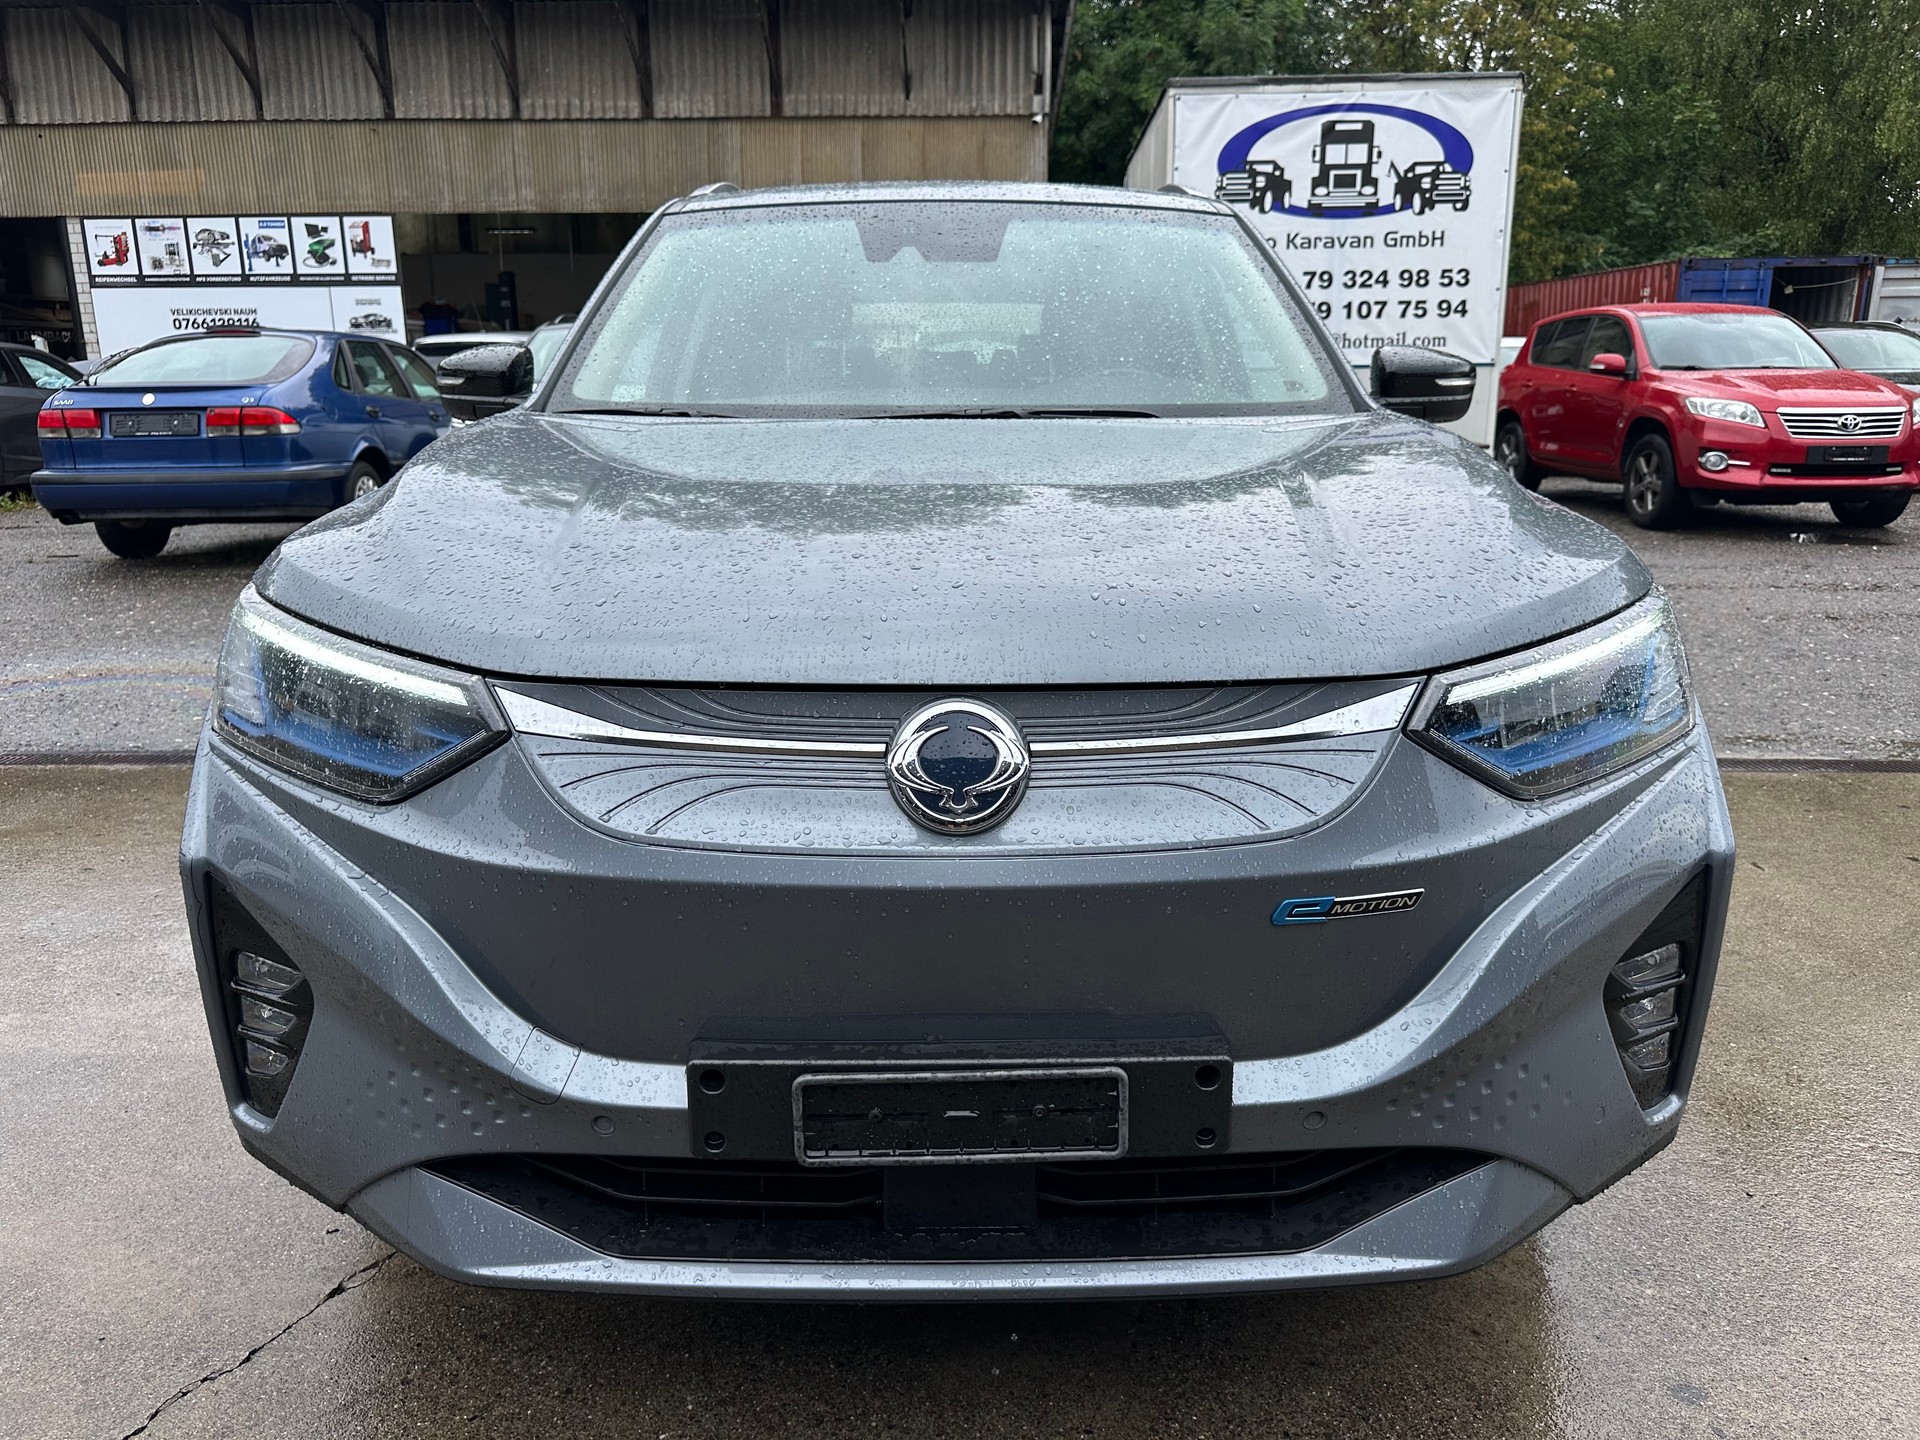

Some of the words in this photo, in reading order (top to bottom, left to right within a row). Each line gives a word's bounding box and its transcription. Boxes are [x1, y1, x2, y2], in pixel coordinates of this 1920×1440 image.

[1286, 232, 1375, 250] Karavan
[1383, 230, 1445, 248] GmbH
[1302, 270, 1333, 290] 79
[1342, 269, 1390, 289] 324
[1398, 268, 1430, 288] 98
[1438, 268, 1471, 287] 53
[170, 308, 232, 316] VELIKICHEVSKI
[233, 308, 258, 316] NAUM
[1312, 301, 1332, 320] 9
[1342, 300, 1388, 320] 107
[1398, 300, 1428, 319] 75
[1436, 299, 1469, 318] 94
